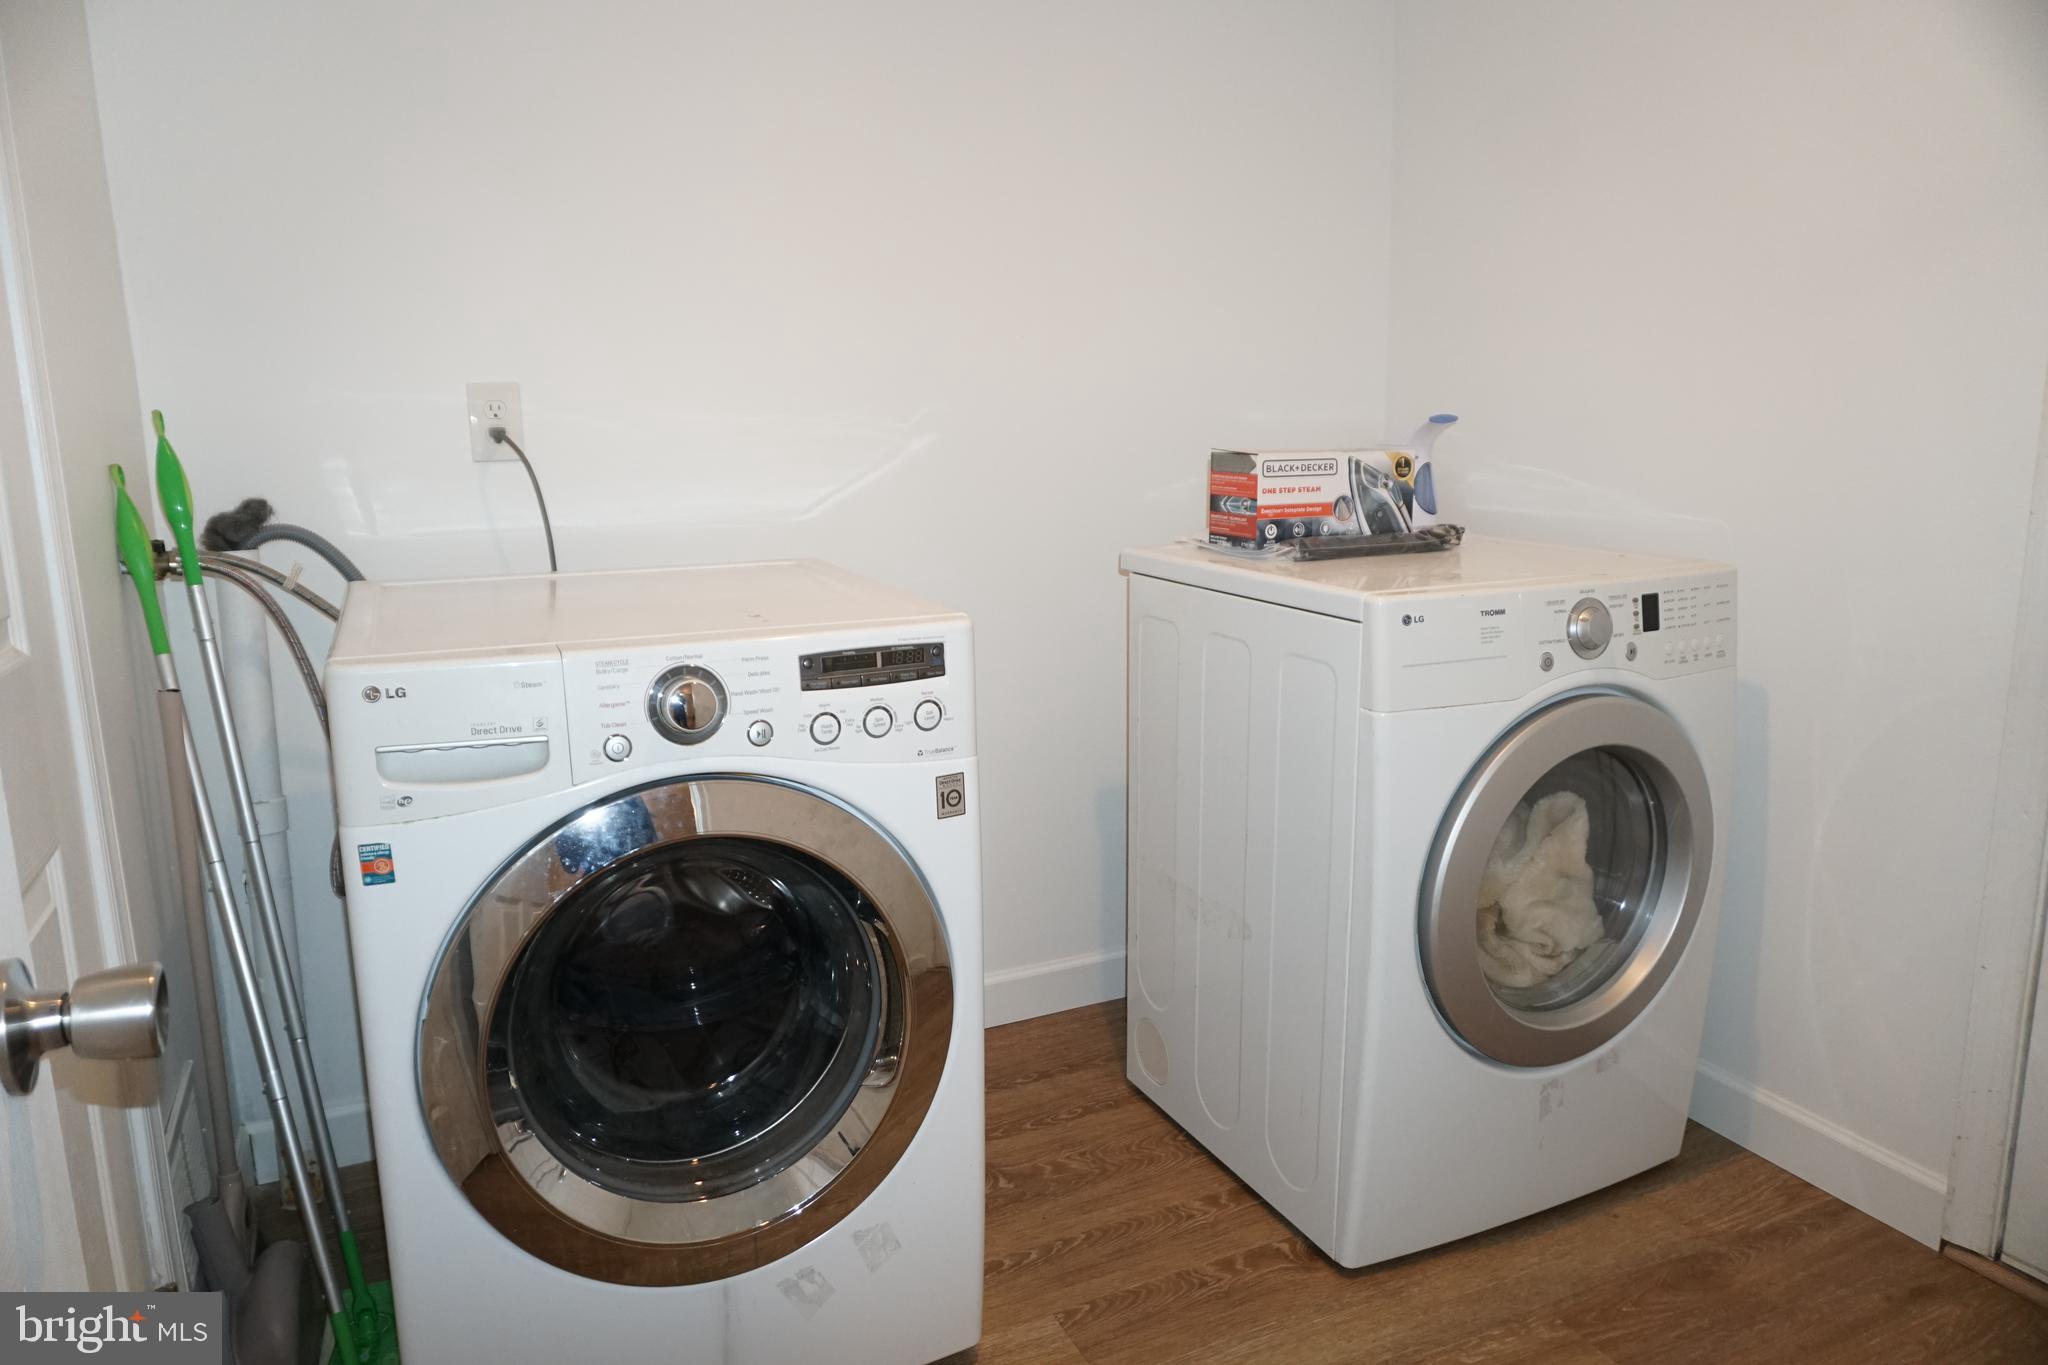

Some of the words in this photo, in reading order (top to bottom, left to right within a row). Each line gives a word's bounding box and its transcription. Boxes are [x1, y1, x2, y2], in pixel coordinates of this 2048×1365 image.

[1266, 462, 1335, 473] BLACK+DECKER
[1278, 486, 1297, 494] STEP
[1298, 485, 1322, 493] STEAM
[1480, 608, 1506, 617] TROMM
[1413, 615, 1425, 624] LG
[385, 686, 407, 699] LG
[470, 727, 498, 736] Direct
[499, 725, 522, 735] Drive
[940, 789, 962, 810] 10
